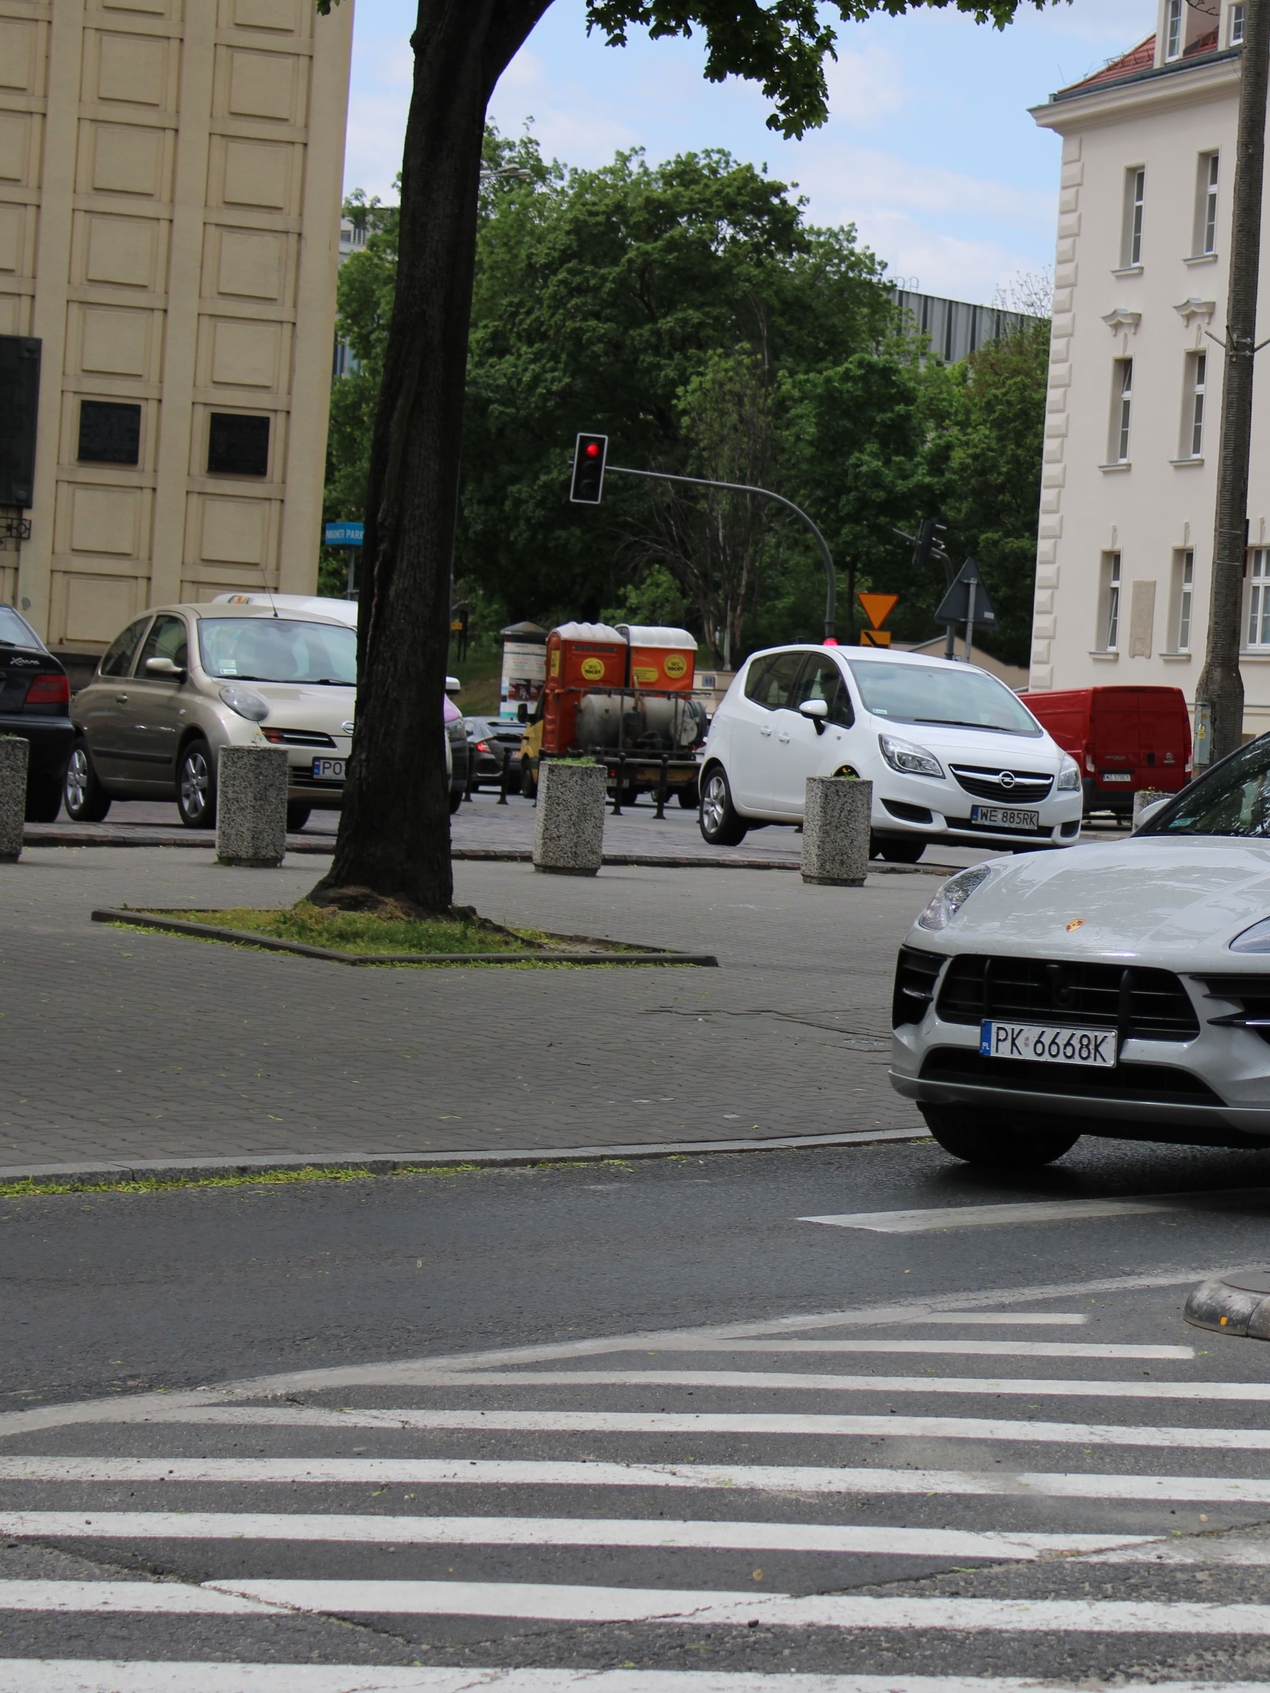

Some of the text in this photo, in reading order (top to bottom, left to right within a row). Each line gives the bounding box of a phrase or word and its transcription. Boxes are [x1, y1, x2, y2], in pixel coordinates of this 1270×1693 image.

[980, 808, 999, 823] WE
[1001, 811, 1037, 827] 885RK
[995, 1026, 1025, 1056] PK
[1033, 1030, 1109, 1063] 6668K
